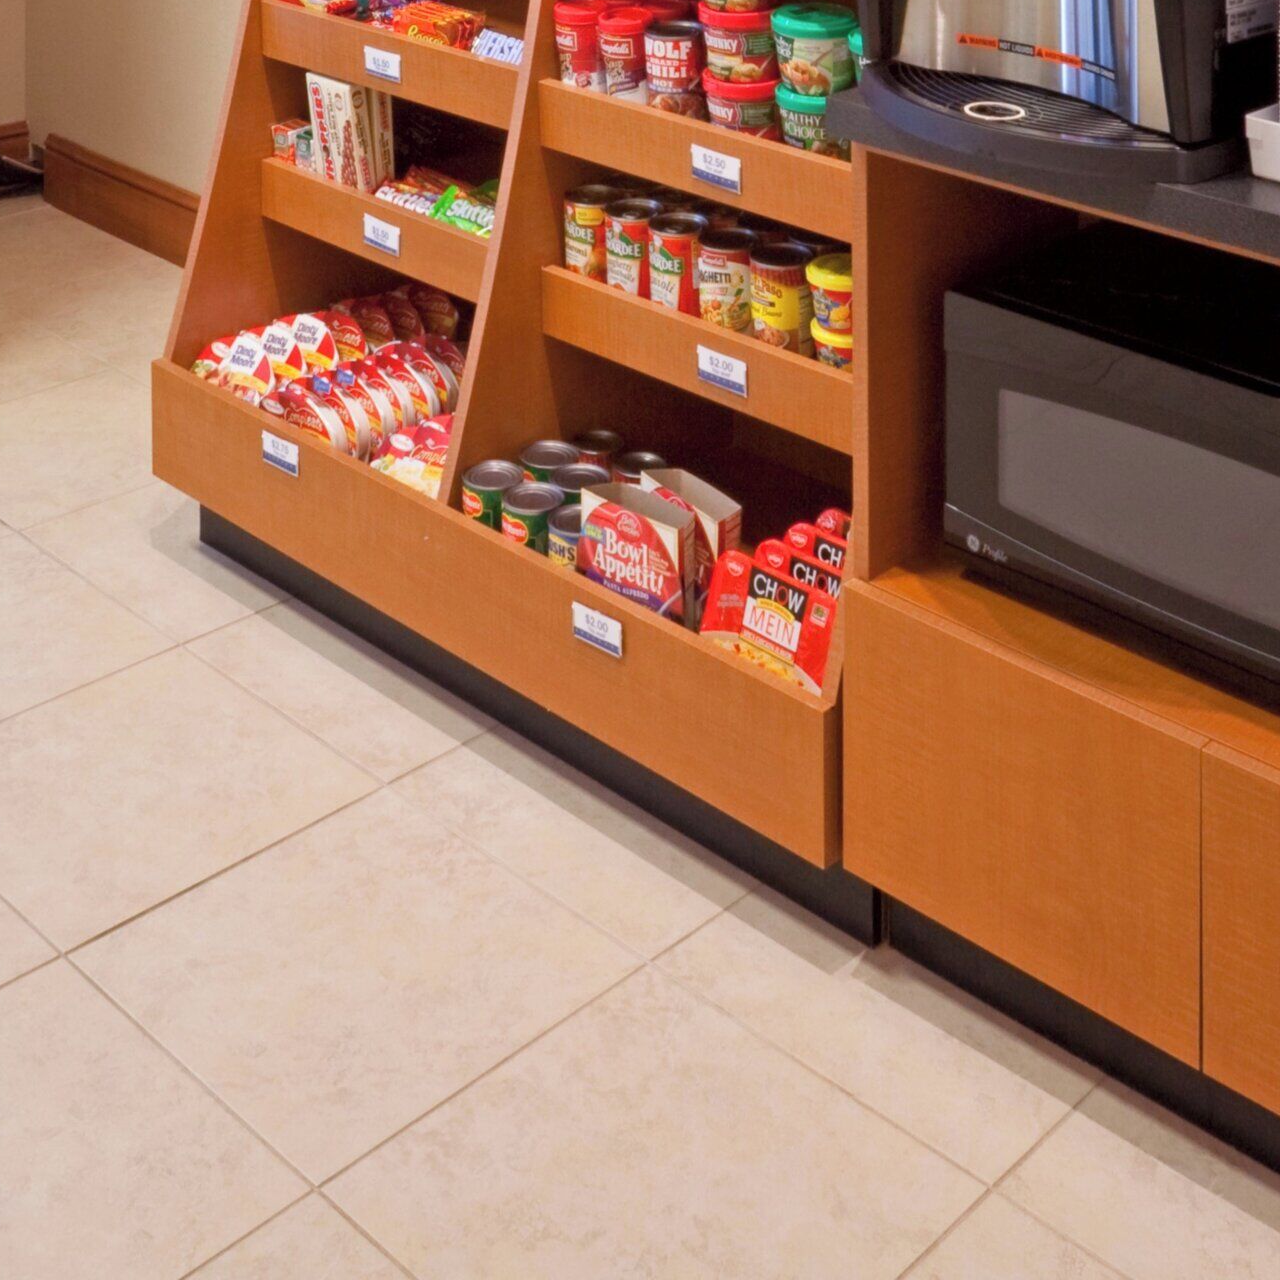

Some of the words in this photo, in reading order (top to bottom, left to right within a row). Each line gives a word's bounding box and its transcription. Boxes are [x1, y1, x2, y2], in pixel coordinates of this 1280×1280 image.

[372, 56, 391, 70] $1.50
[702, 153, 727, 171] $2.50
[371, 226, 390, 240] $1.50
[708, 355, 734, 372] $2.00
[604, 525, 649, 570] Bowl
[592, 542, 665, 597] Appétit!
[792, 562, 841, 599] CHOW
[753, 572, 805, 614] CHOW
[584, 611, 609, 634] $2.00
[750, 606, 795, 646] MEIN
